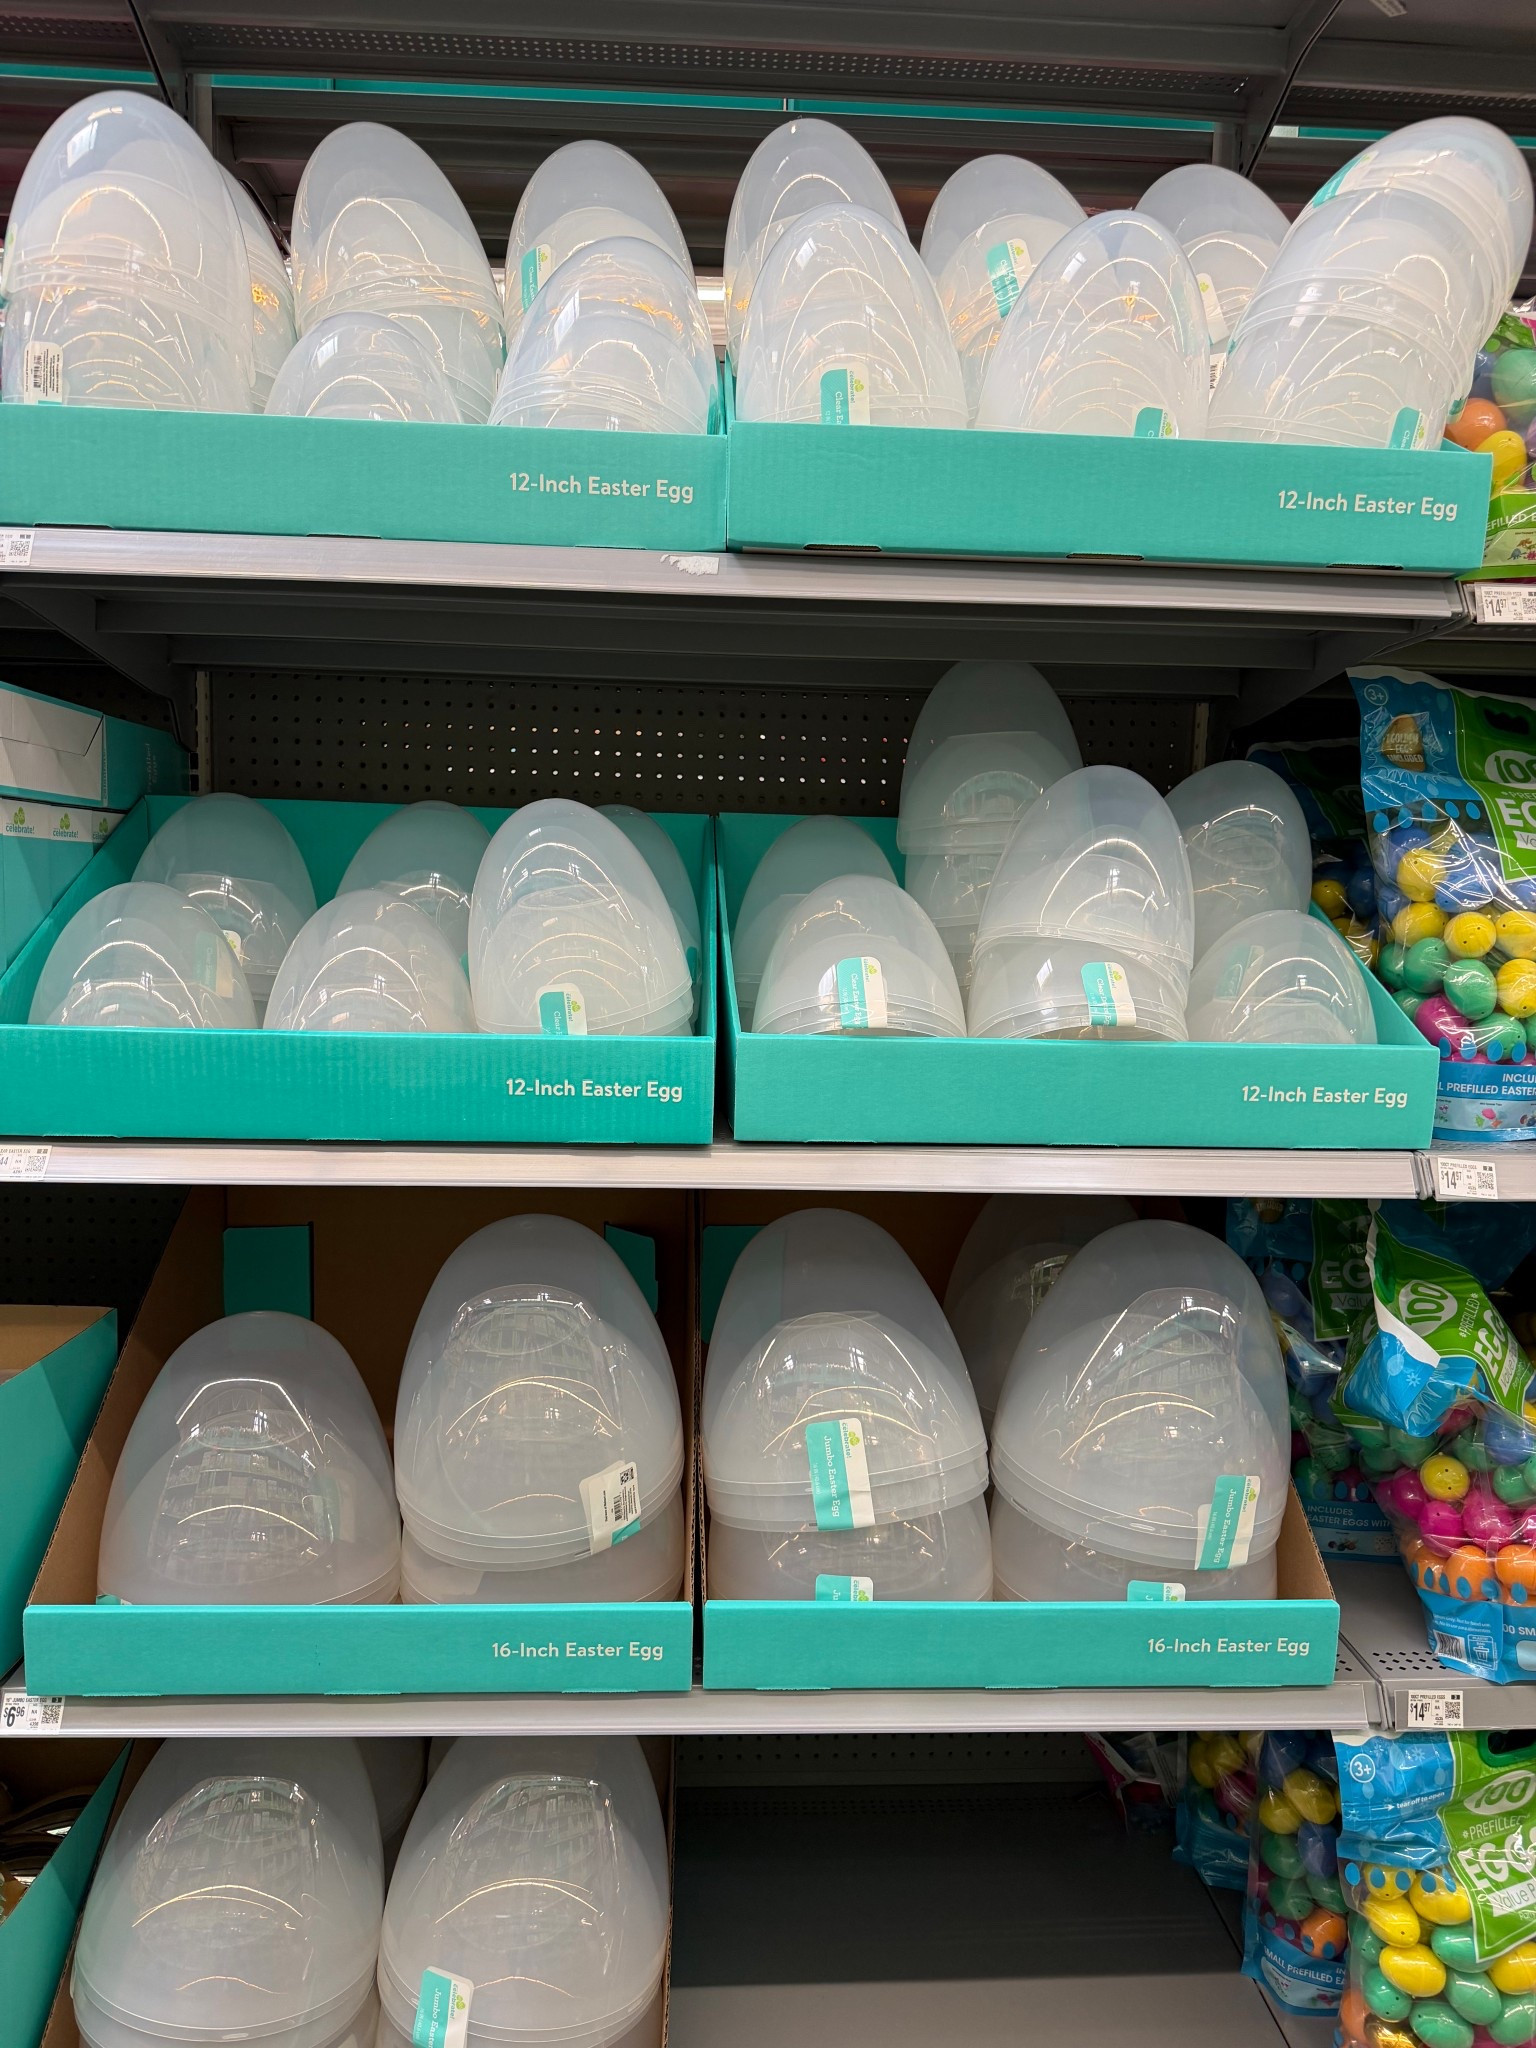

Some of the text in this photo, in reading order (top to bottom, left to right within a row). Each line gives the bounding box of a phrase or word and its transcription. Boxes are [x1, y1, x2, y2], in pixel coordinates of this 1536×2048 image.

[510, 472, 694, 504] 12-Inch Easter Egg
[1278, 491, 1458, 521] 12-Inch Easter Egg
[1369, 688, 1385, 701] 3+
[5, 824, 36, 835] celebrate!
[52, 829, 79, 839] celebrate!
[553, 1010, 562, 1031] Clear
[1446, 1083, 1499, 1095] PREFILLED
[1502, 1073, 1536, 1084] INCLU
[506, 1078, 683, 1104] 12-Inch Easter Egg
[1242, 1085, 1408, 1109] 12-Inch Easter Egg
[1404, 1282, 1449, 1326] 100
[842, 1422, 852, 1459] celebrate!
[823, 1435, 841, 1518] Jumbo Easter Egg
[1242, 1478, 1252, 1512] celebrate!
[1307, 1505, 1353, 1517] INCLUDES
[1307, 1515, 1340, 1526] EASTER
[1343, 1518, 1370, 1528] EGGS
[1213, 1488, 1236, 1564] Jumbo Easter Egg
[492, 1642, 664, 1661] 16-Inch Easter Egg
[1148, 1637, 1310, 1657] 16-Inch Easter Egg
[1353, 1761, 1372, 1777] 3+
[1396, 1800, 1411, 1809] tear
[1411, 1798, 1421, 1806] off
[1427, 1791, 1445, 1802] open
[1474, 1776, 1532, 1809] 100
[1492, 1889, 1529, 1910] Value
[1287, 1964, 1333, 1983] PREFILLED
[432, 1988, 442, 2019] Jumbo
[450, 1983, 459, 2020] celebrate!
